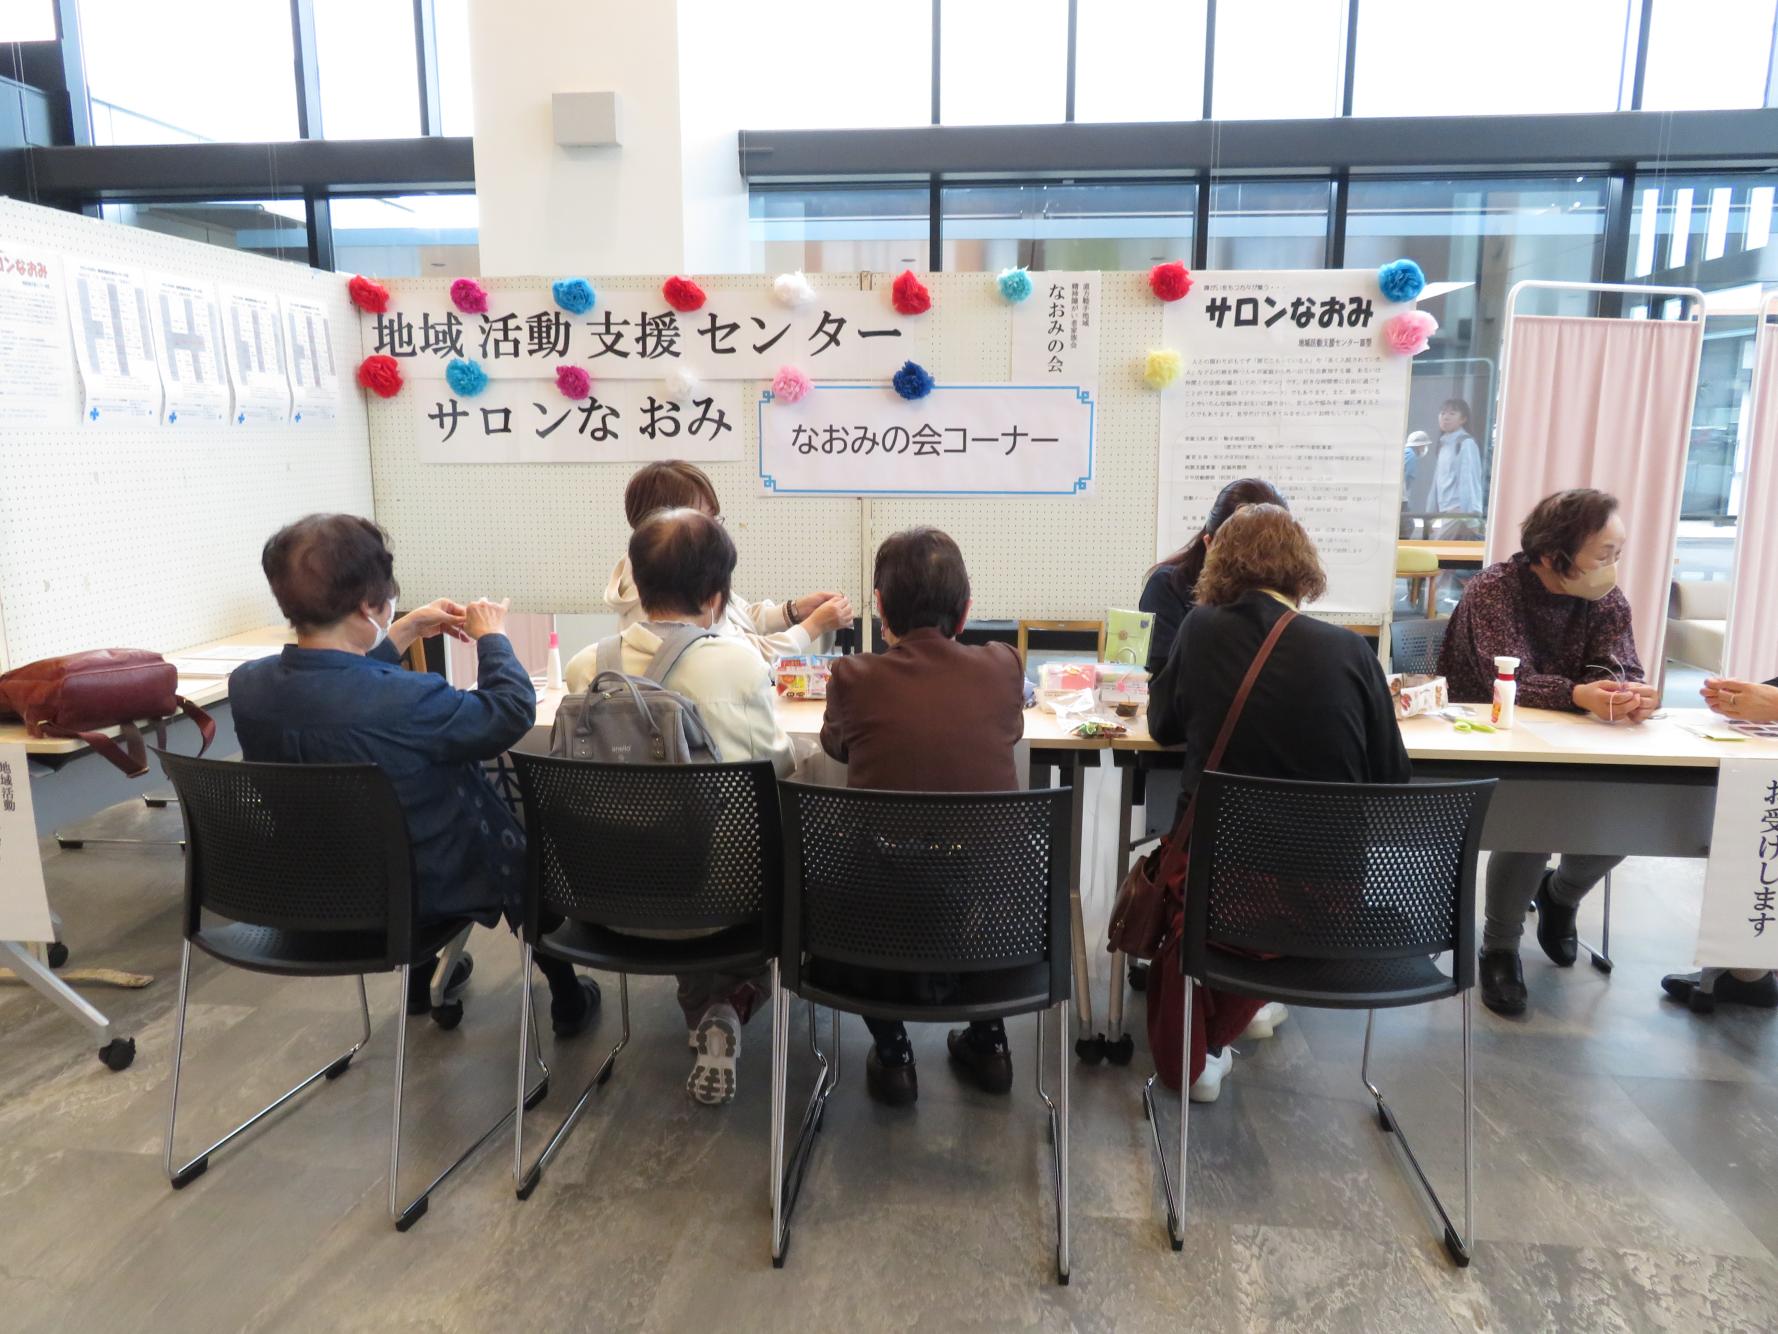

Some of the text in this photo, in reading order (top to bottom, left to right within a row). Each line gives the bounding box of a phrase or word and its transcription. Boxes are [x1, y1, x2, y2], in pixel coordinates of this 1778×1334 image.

[371, 309, 903, 360] 地域活動支援センター
[1047, 283, 1065, 373] なおみの会
[1205, 295, 1374, 329] サロンなおみ
[427, 394, 734, 445] サロンなおみ
[791, 423, 1060, 458] なおみの会コーナー
